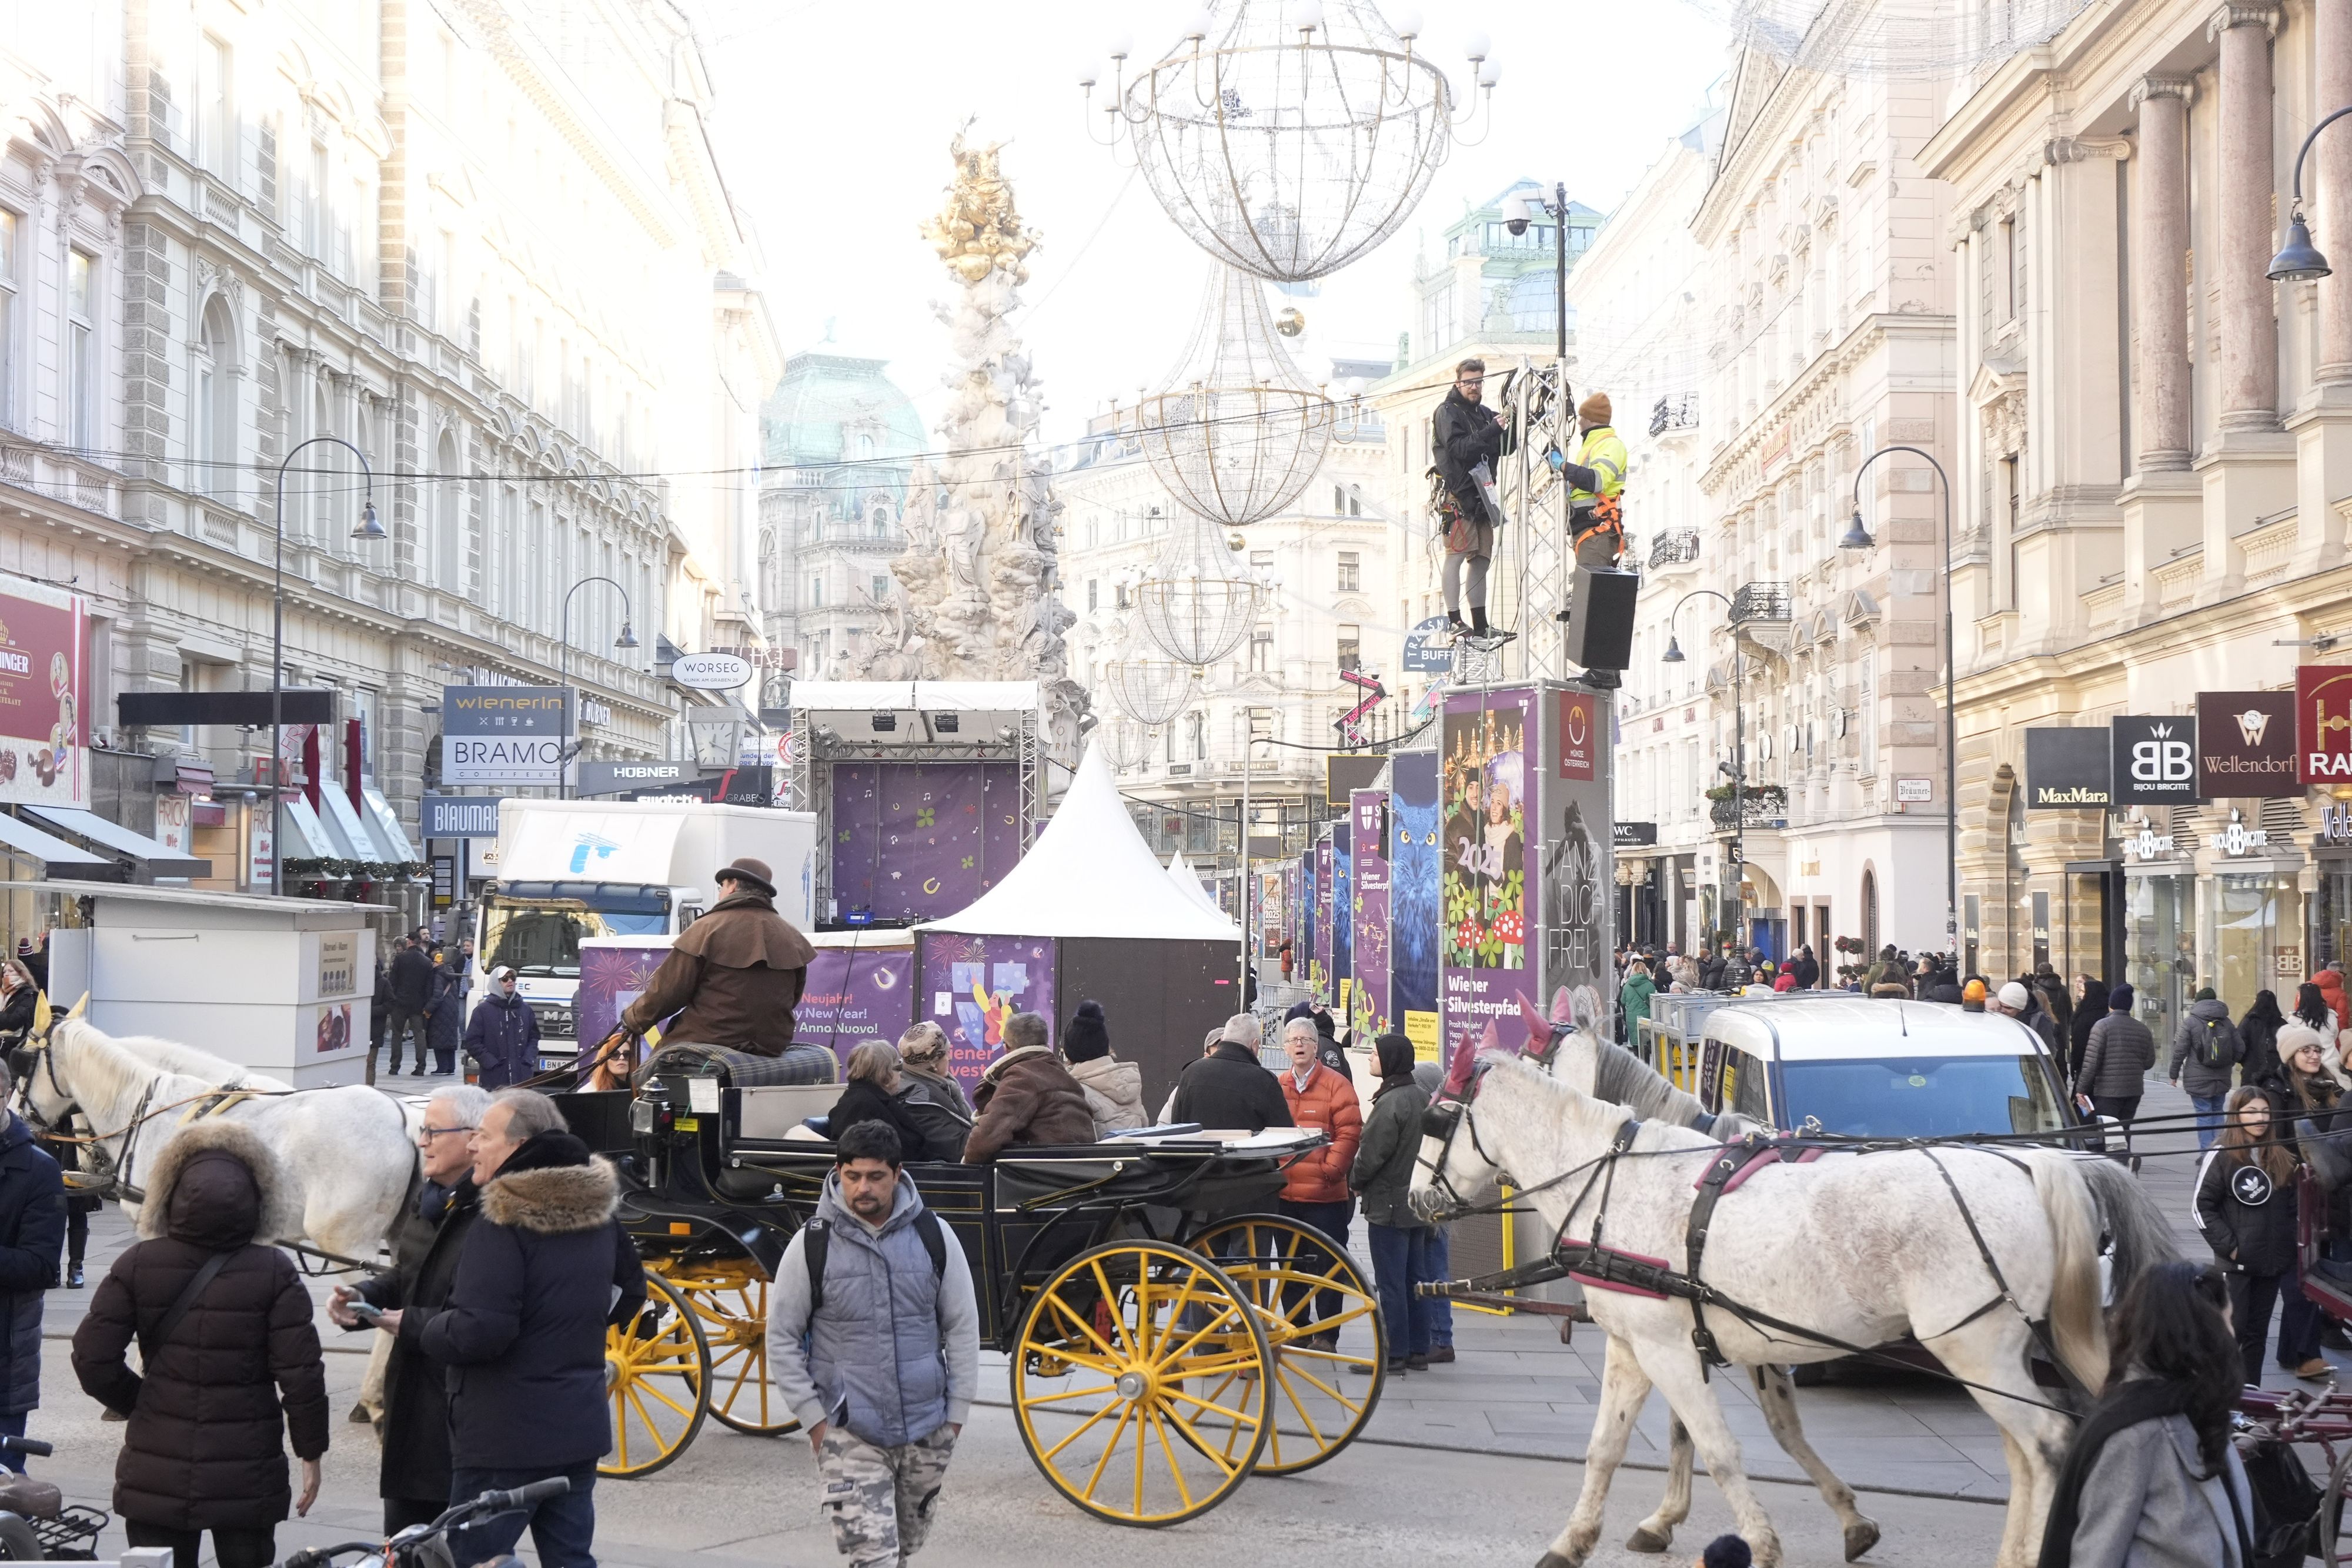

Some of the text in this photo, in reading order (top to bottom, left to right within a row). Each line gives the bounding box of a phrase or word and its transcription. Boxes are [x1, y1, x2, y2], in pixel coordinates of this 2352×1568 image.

[684, 663, 739, 673] WORSEG
[1342, 672, 1379, 687] DISCOHEQUE
[456, 696, 562, 709] wienerin
[586, 698, 611, 726] HÜBNER
[1570, 749, 1585, 758] MÜNZE
[1564, 758, 1589, 768] ÖSTERREICH
[613, 767, 679, 778] HÜBNER
[2133, 783, 2156, 792] BIJOU
[637, 794, 692, 804] swatch
[2037, 787, 2108, 804] MaxMara
[158, 797, 188, 828] FRICK
[166, 834, 178, 848] Die
[260, 840, 270, 852] Die
[1458, 836, 1502, 881] 2025
[1547, 839, 1599, 881] TANZ
[1361, 872, 1381, 881] Wiener
[1560, 884, 1605, 925] DICH
[1548, 928, 1589, 969] FREI
[1448, 975, 1489, 993] Wiener
[801, 993, 853, 1007] Neujahr!
[806, 1007, 833, 1019] New
[836, 1008, 867, 1019] Year!
[1448, 996, 1522, 1019] Silvesterpfad
[799, 1022, 831, 1033] Anno
[835, 1022, 878, 1034] Nuovo!
[1448, 1019, 1482, 1031] Prosit Nejahr!
[948, 1044, 994, 1061] iener
[2249, 1185, 2266, 1199] adidas
